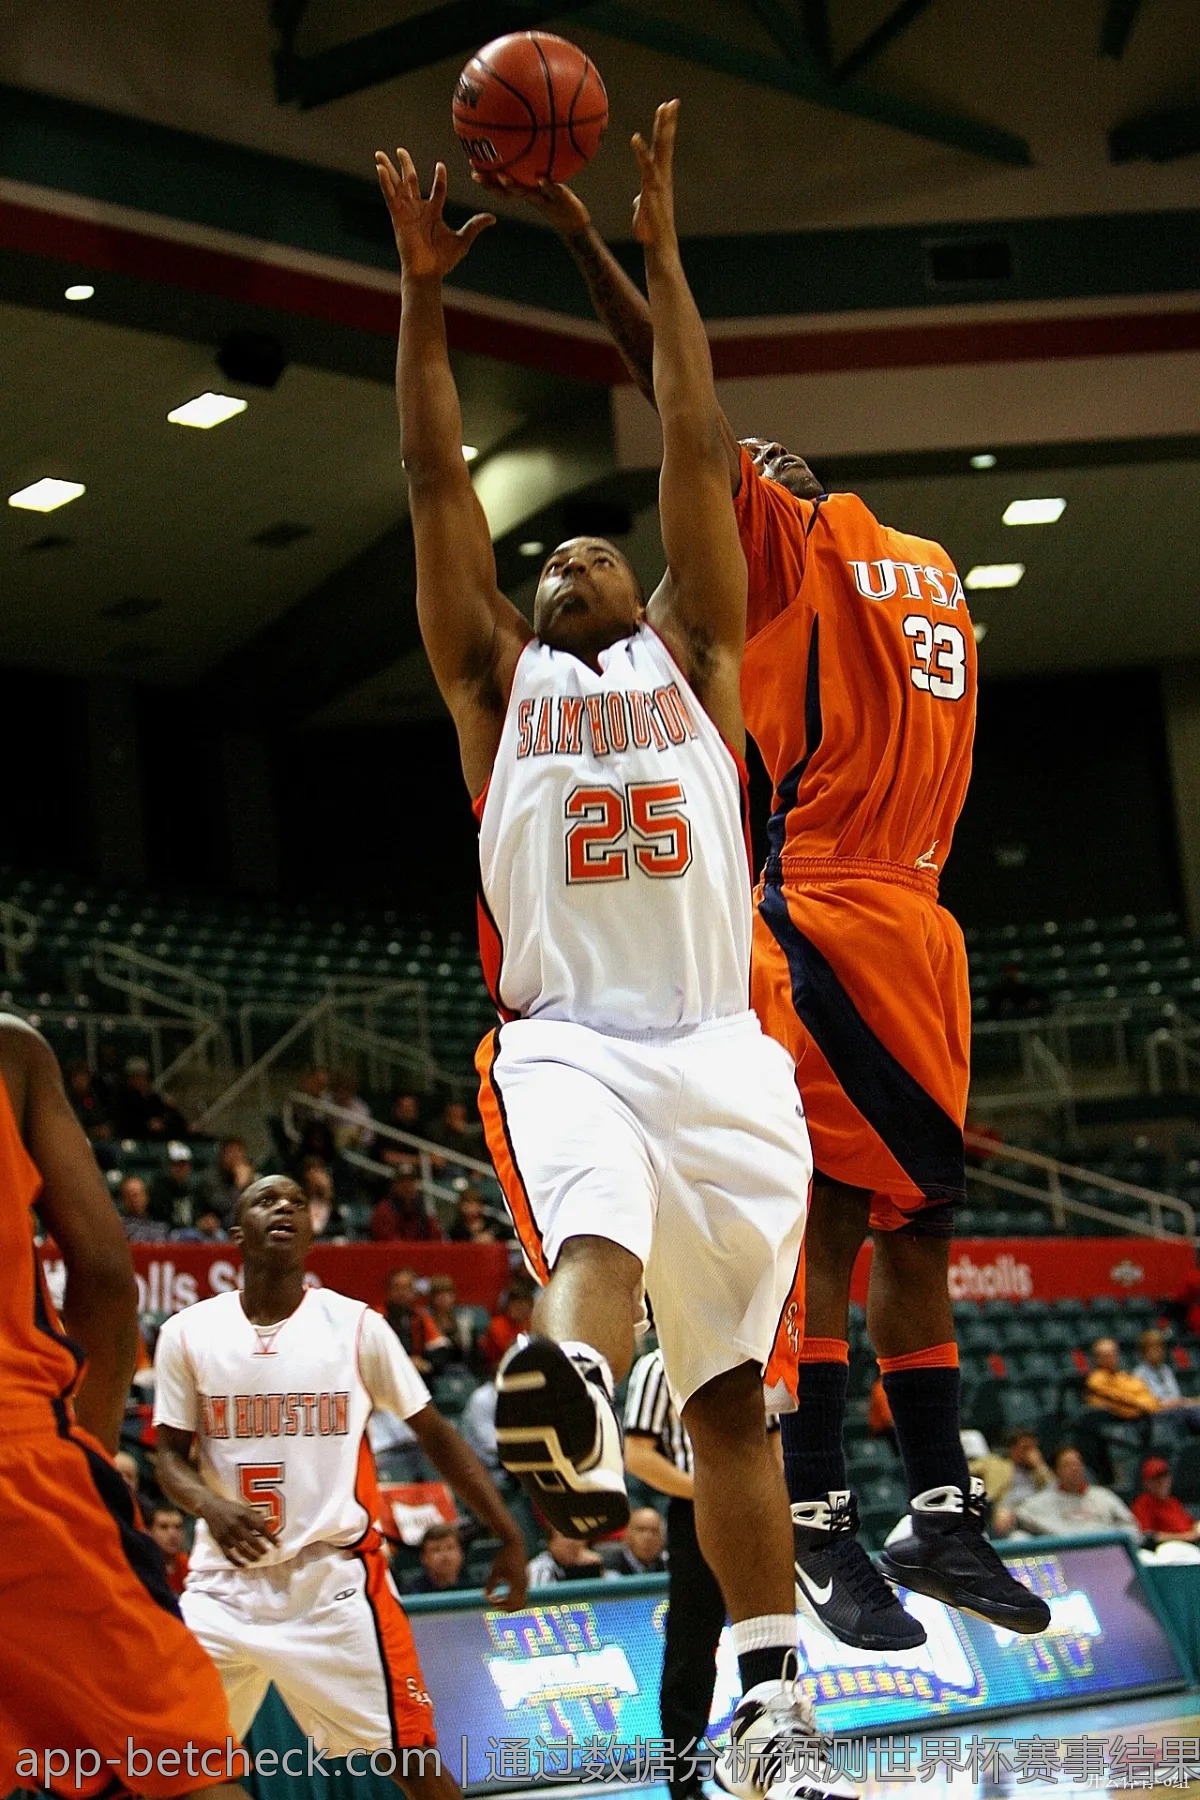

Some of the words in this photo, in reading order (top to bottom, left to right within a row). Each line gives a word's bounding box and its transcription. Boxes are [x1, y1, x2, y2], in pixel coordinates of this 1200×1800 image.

[847, 559, 966, 611] UTSA
[902, 614, 967, 702] 33
[565, 778, 694, 885] 25
[236, 1461, 287, 1537] 5
